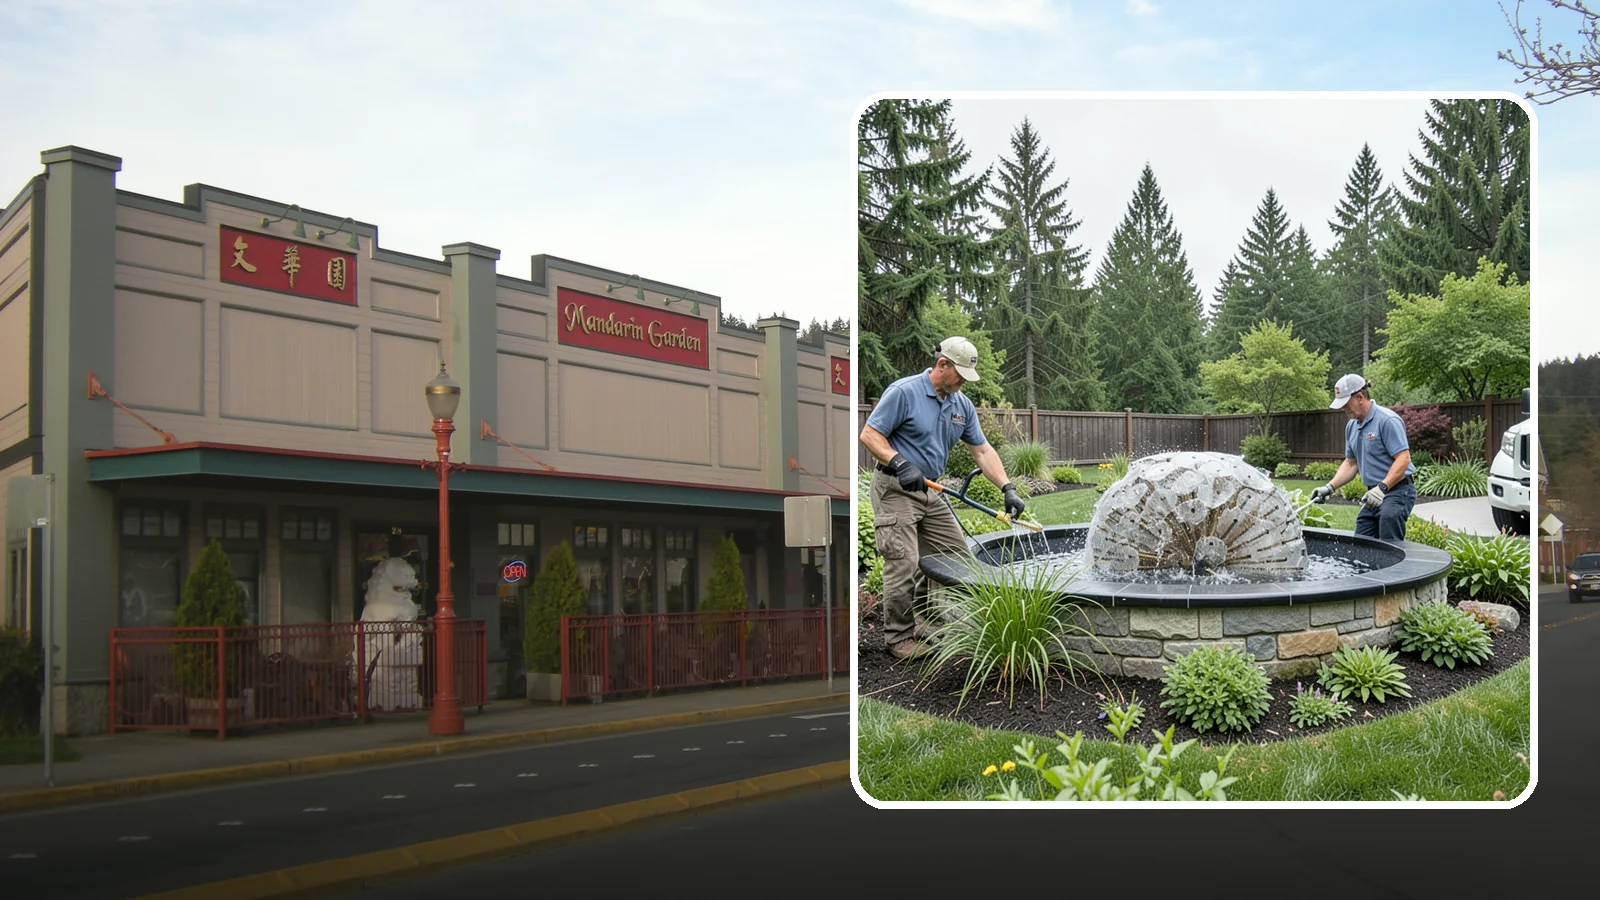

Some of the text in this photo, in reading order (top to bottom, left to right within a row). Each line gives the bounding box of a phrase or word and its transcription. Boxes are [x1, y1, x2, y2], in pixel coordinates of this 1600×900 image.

[564, 302, 702, 352] Mandarin Garden
[503, 565, 527, 578] OPEN
